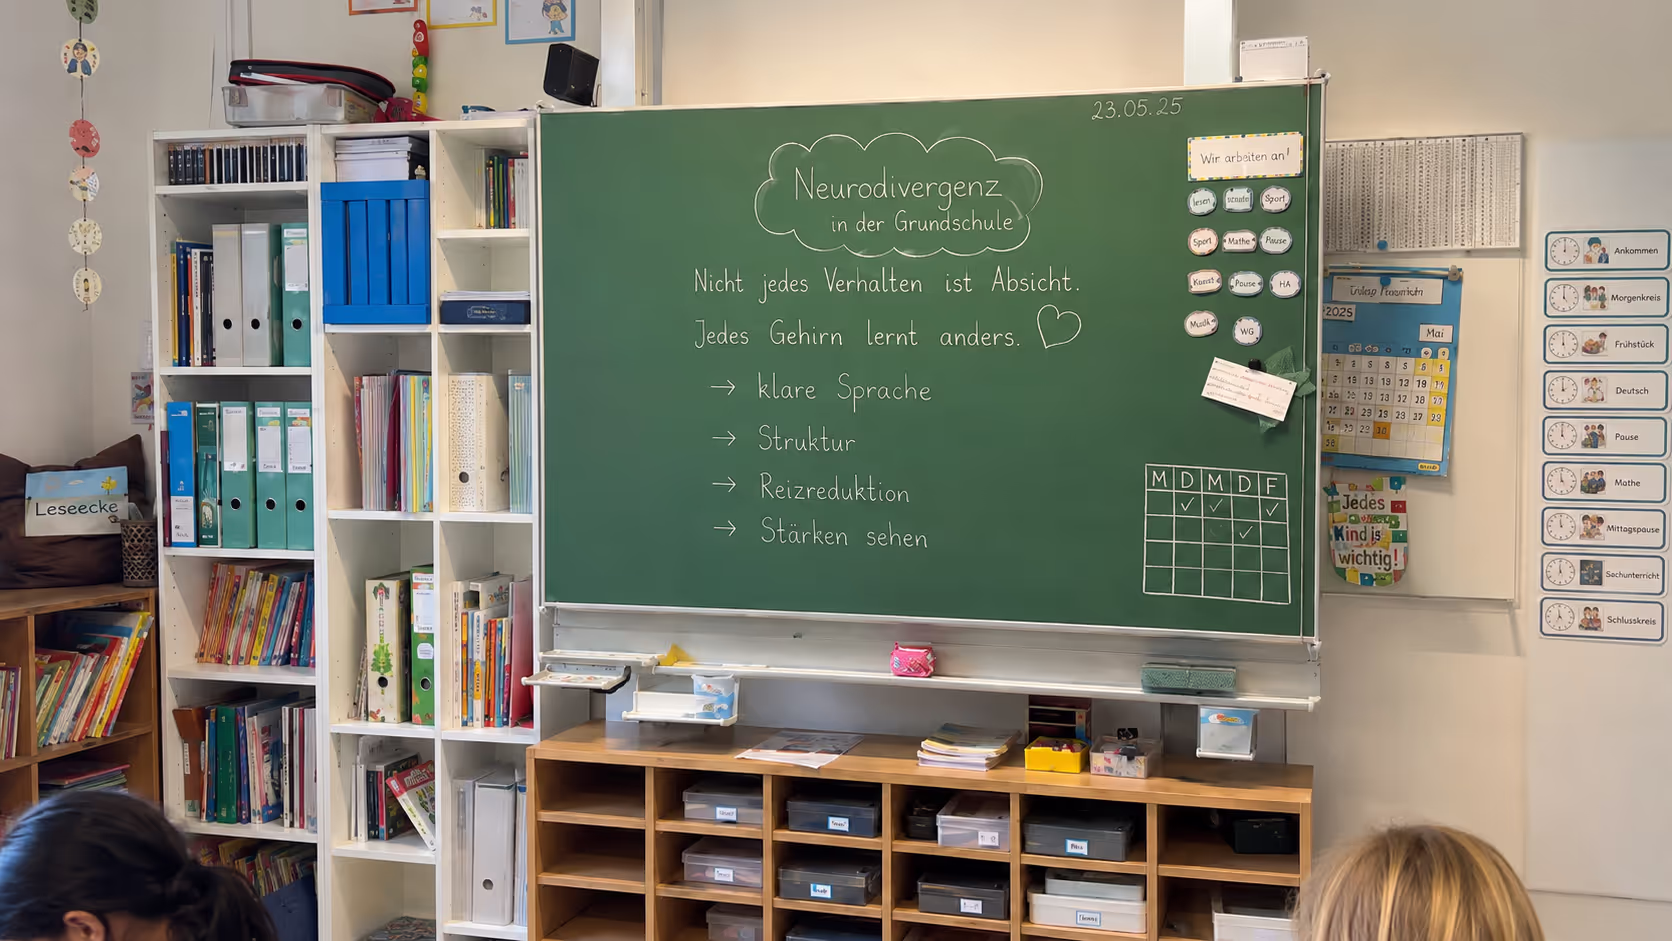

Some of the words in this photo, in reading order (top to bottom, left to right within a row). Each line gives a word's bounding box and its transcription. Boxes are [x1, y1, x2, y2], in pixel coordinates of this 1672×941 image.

[1092, 96, 1184, 121] 23.05.25
[1200, 153, 1220, 164] Wir
[1225, 151, 1268, 163] arbeiten
[794, 166, 1003, 211] Neurodivergenz
[831, 215, 849, 233] in
[855, 211, 885, 233] der
[894, 209, 1014, 232] Grundschule
[1614, 247, 1659, 255] Ankommen
[693, 267, 745, 293] Nicht
[758, 268, 810, 304] jedes
[823, 266, 923, 293] Verhalten
[945, 272, 973, 293] ist
[990, 265, 1080, 292] Absicht.
[1279, 280, 1291, 288] HA
[1611, 294, 1661, 303] Morgenkreis
[693, 318, 750, 349] Jedes
[769, 318, 843, 346] Gehirn
[866, 318, 919, 346] lernt
[939, 319, 1021, 347] anders.
[1240, 328, 1254, 336] WG
[1426, 328, 1444, 338] Mai
[1615, 340, 1654, 348] Frühstück
[757, 371, 817, 400] klare
[836, 372, 933, 413] Sprache
[1616, 387, 1649, 395] Deutsch
[758, 424, 856, 453] Struktur
[1615, 433, 1639, 441] Pause
[759, 471, 910, 504] Reizreduktion
[1152, 470, 1167, 488] M
[1181, 471, 1194, 489] D
[1208, 474, 1224, 491] M
[1238, 475, 1251, 493] D
[1266, 477, 1277, 495] F
[35, 500, 118, 516] Leseecke
[1342, 494, 1385, 510] Jedes
[760, 516, 849, 546] Stärken
[866, 522, 928, 549] sehen
[1333, 525, 1367, 541] Kind
[1606, 524, 1660, 534] Mittagspause
[1339, 549, 1398, 571] wichtig!
[1605, 571, 1660, 580] Sachunterricht
[1607, 616, 1657, 626] Schlusskreis
